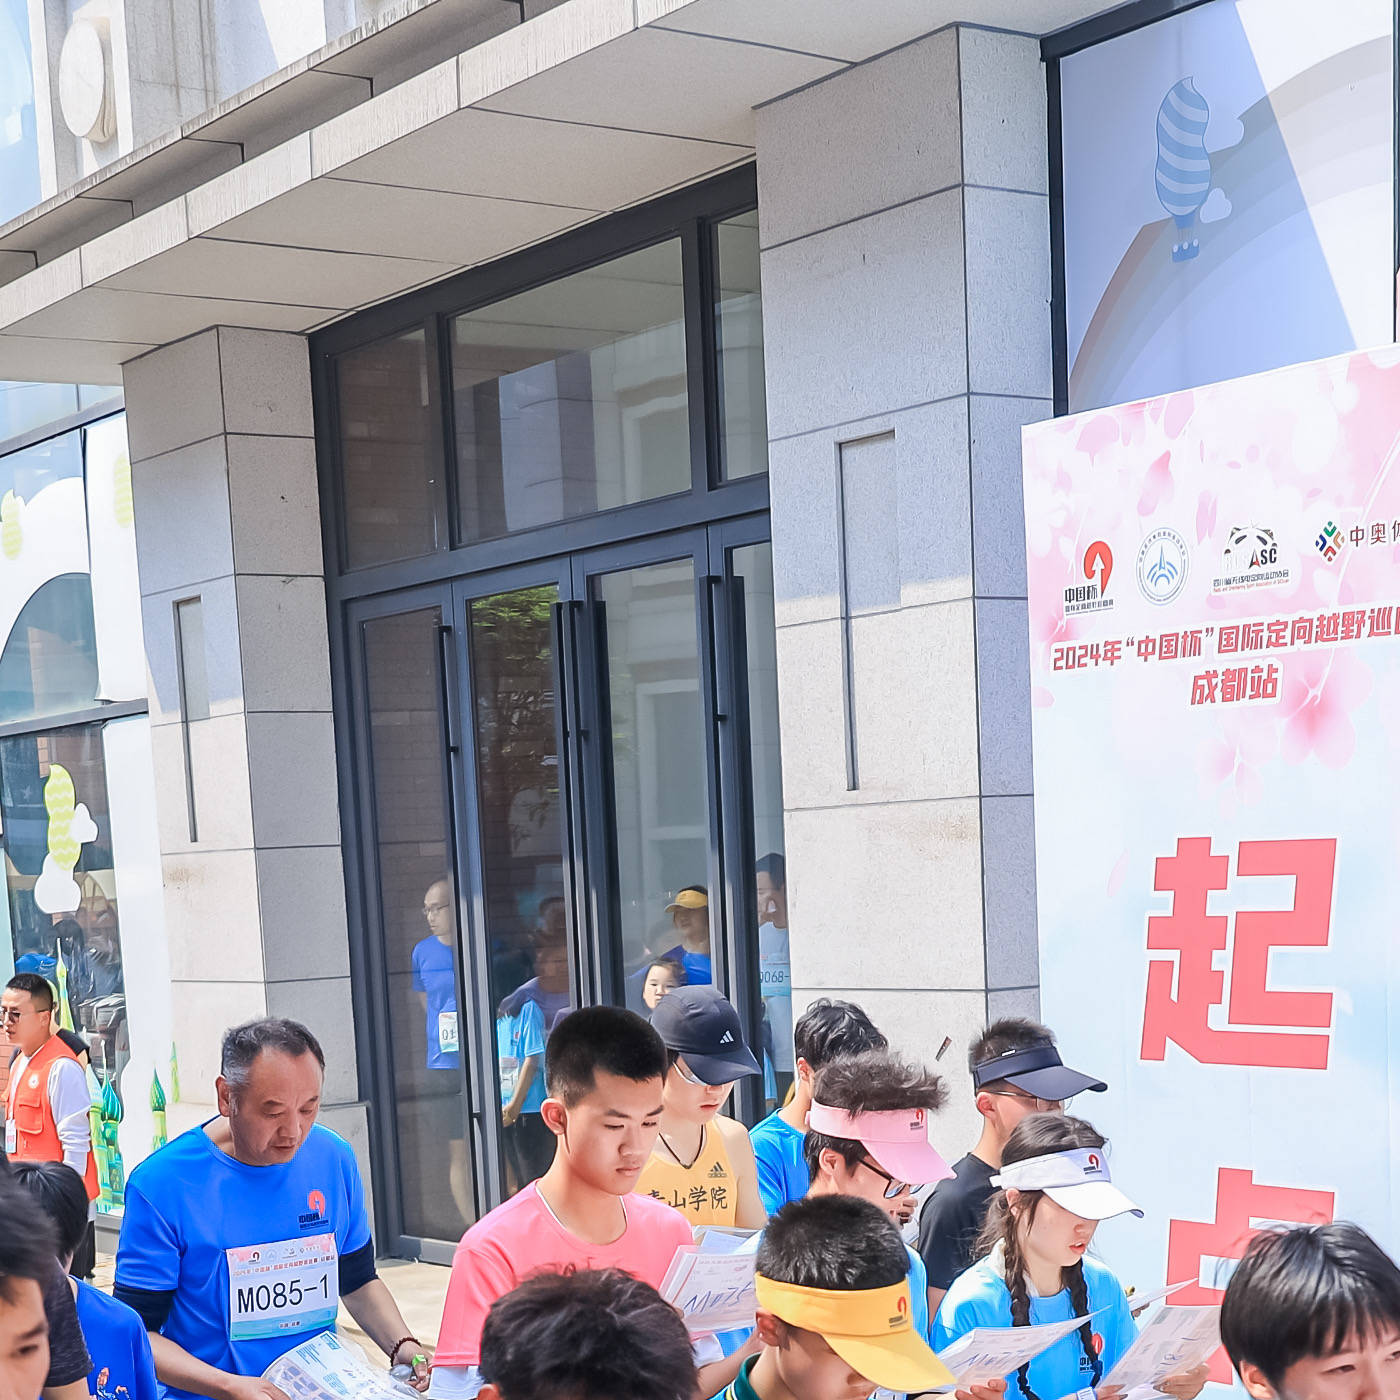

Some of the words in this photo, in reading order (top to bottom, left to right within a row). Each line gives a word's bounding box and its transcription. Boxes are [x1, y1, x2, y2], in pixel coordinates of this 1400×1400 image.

[1064, 583, 1099, 604] 中国杯
[1190, 663, 1279, 706] 成都站
[237, 1273, 329, 1314] M085-1
